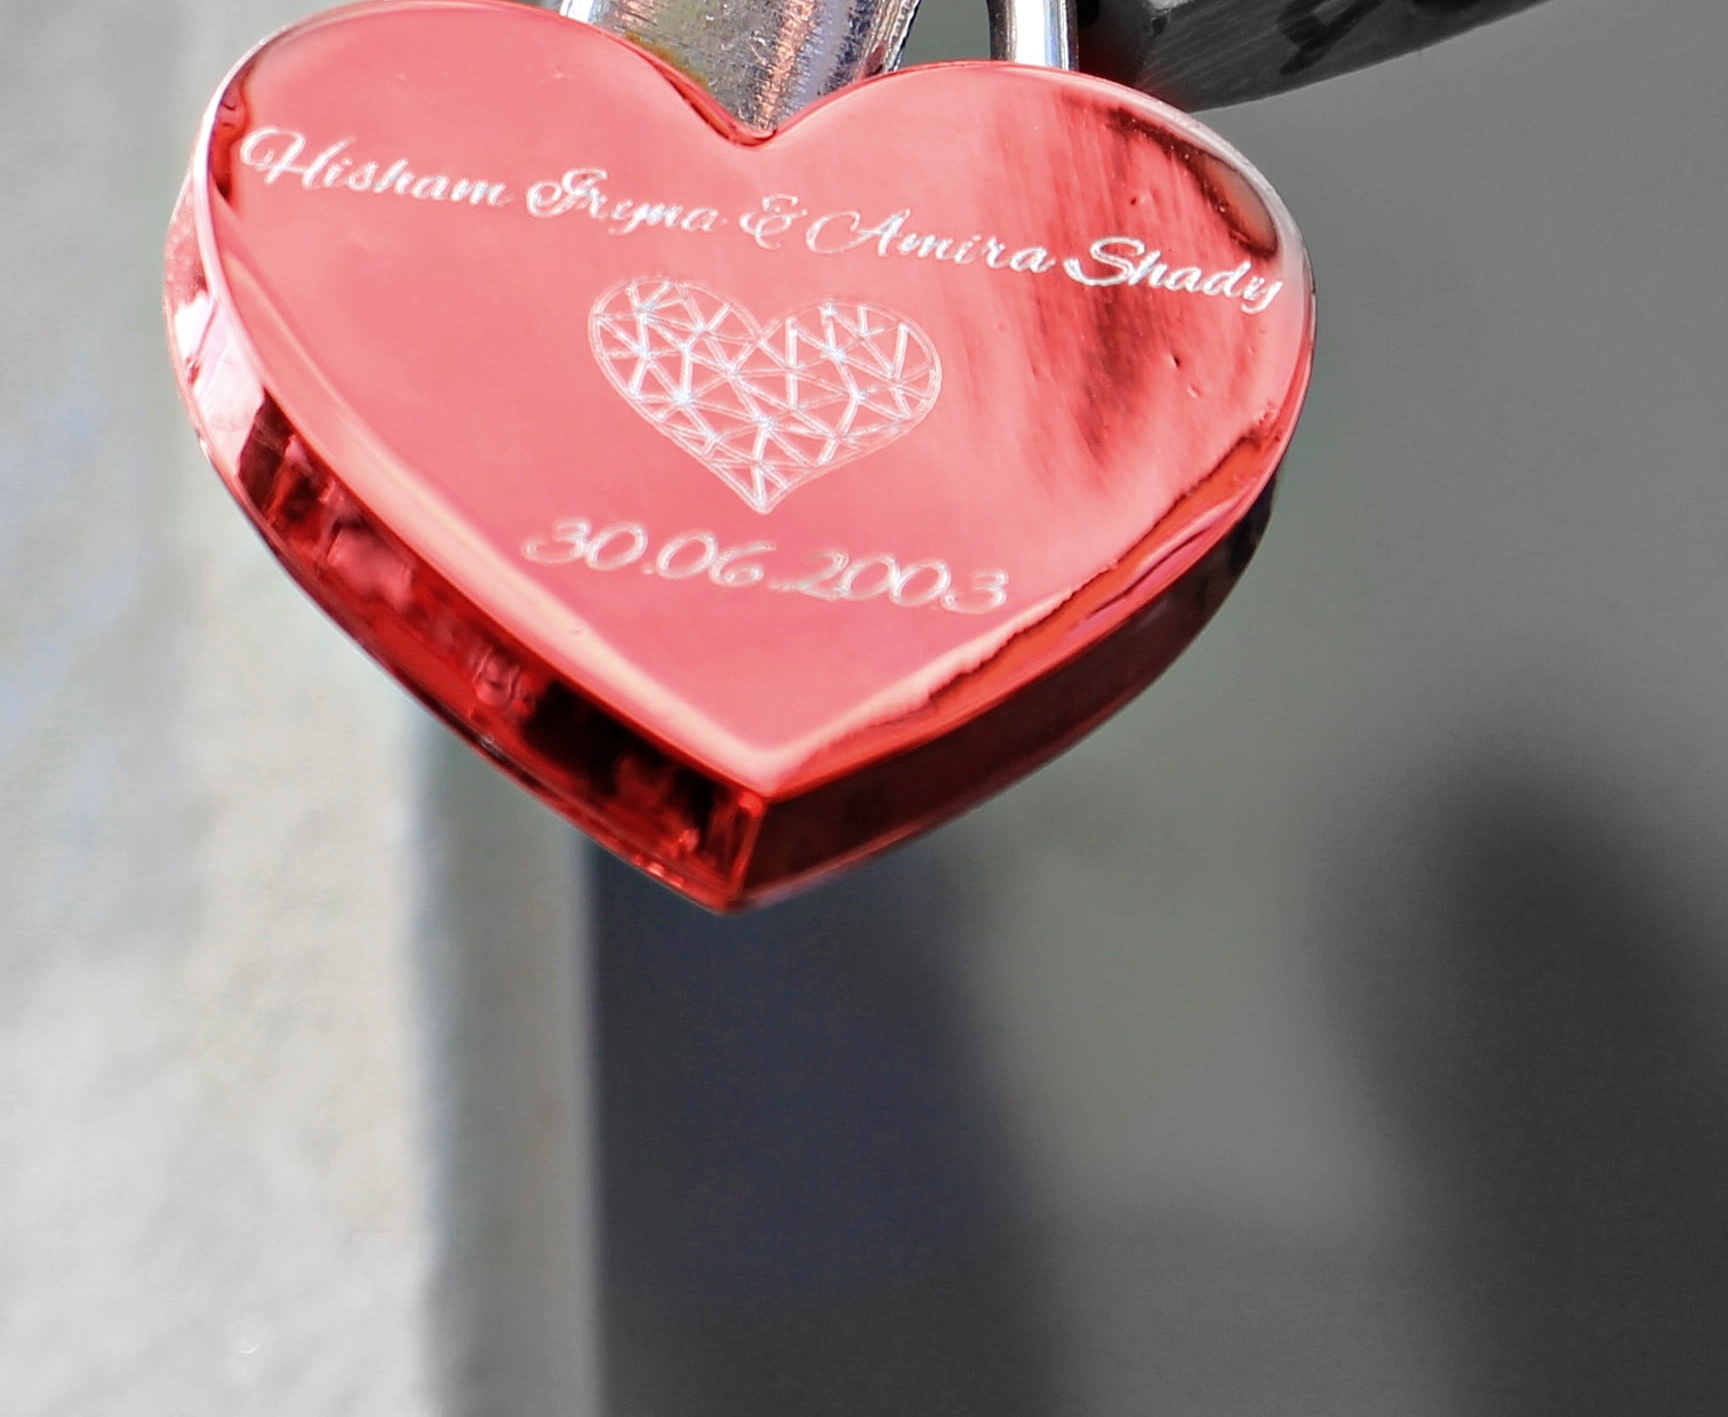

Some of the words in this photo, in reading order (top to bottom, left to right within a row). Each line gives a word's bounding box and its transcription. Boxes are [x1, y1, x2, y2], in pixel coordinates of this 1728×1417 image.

[239, 127, 514, 208] Hisham
[738, 193, 808, 249] &
[805, 208, 1057, 273] Amira
[1062, 235, 1284, 314] Shady
[521, 516, 1009, 615] 30.06.2003
